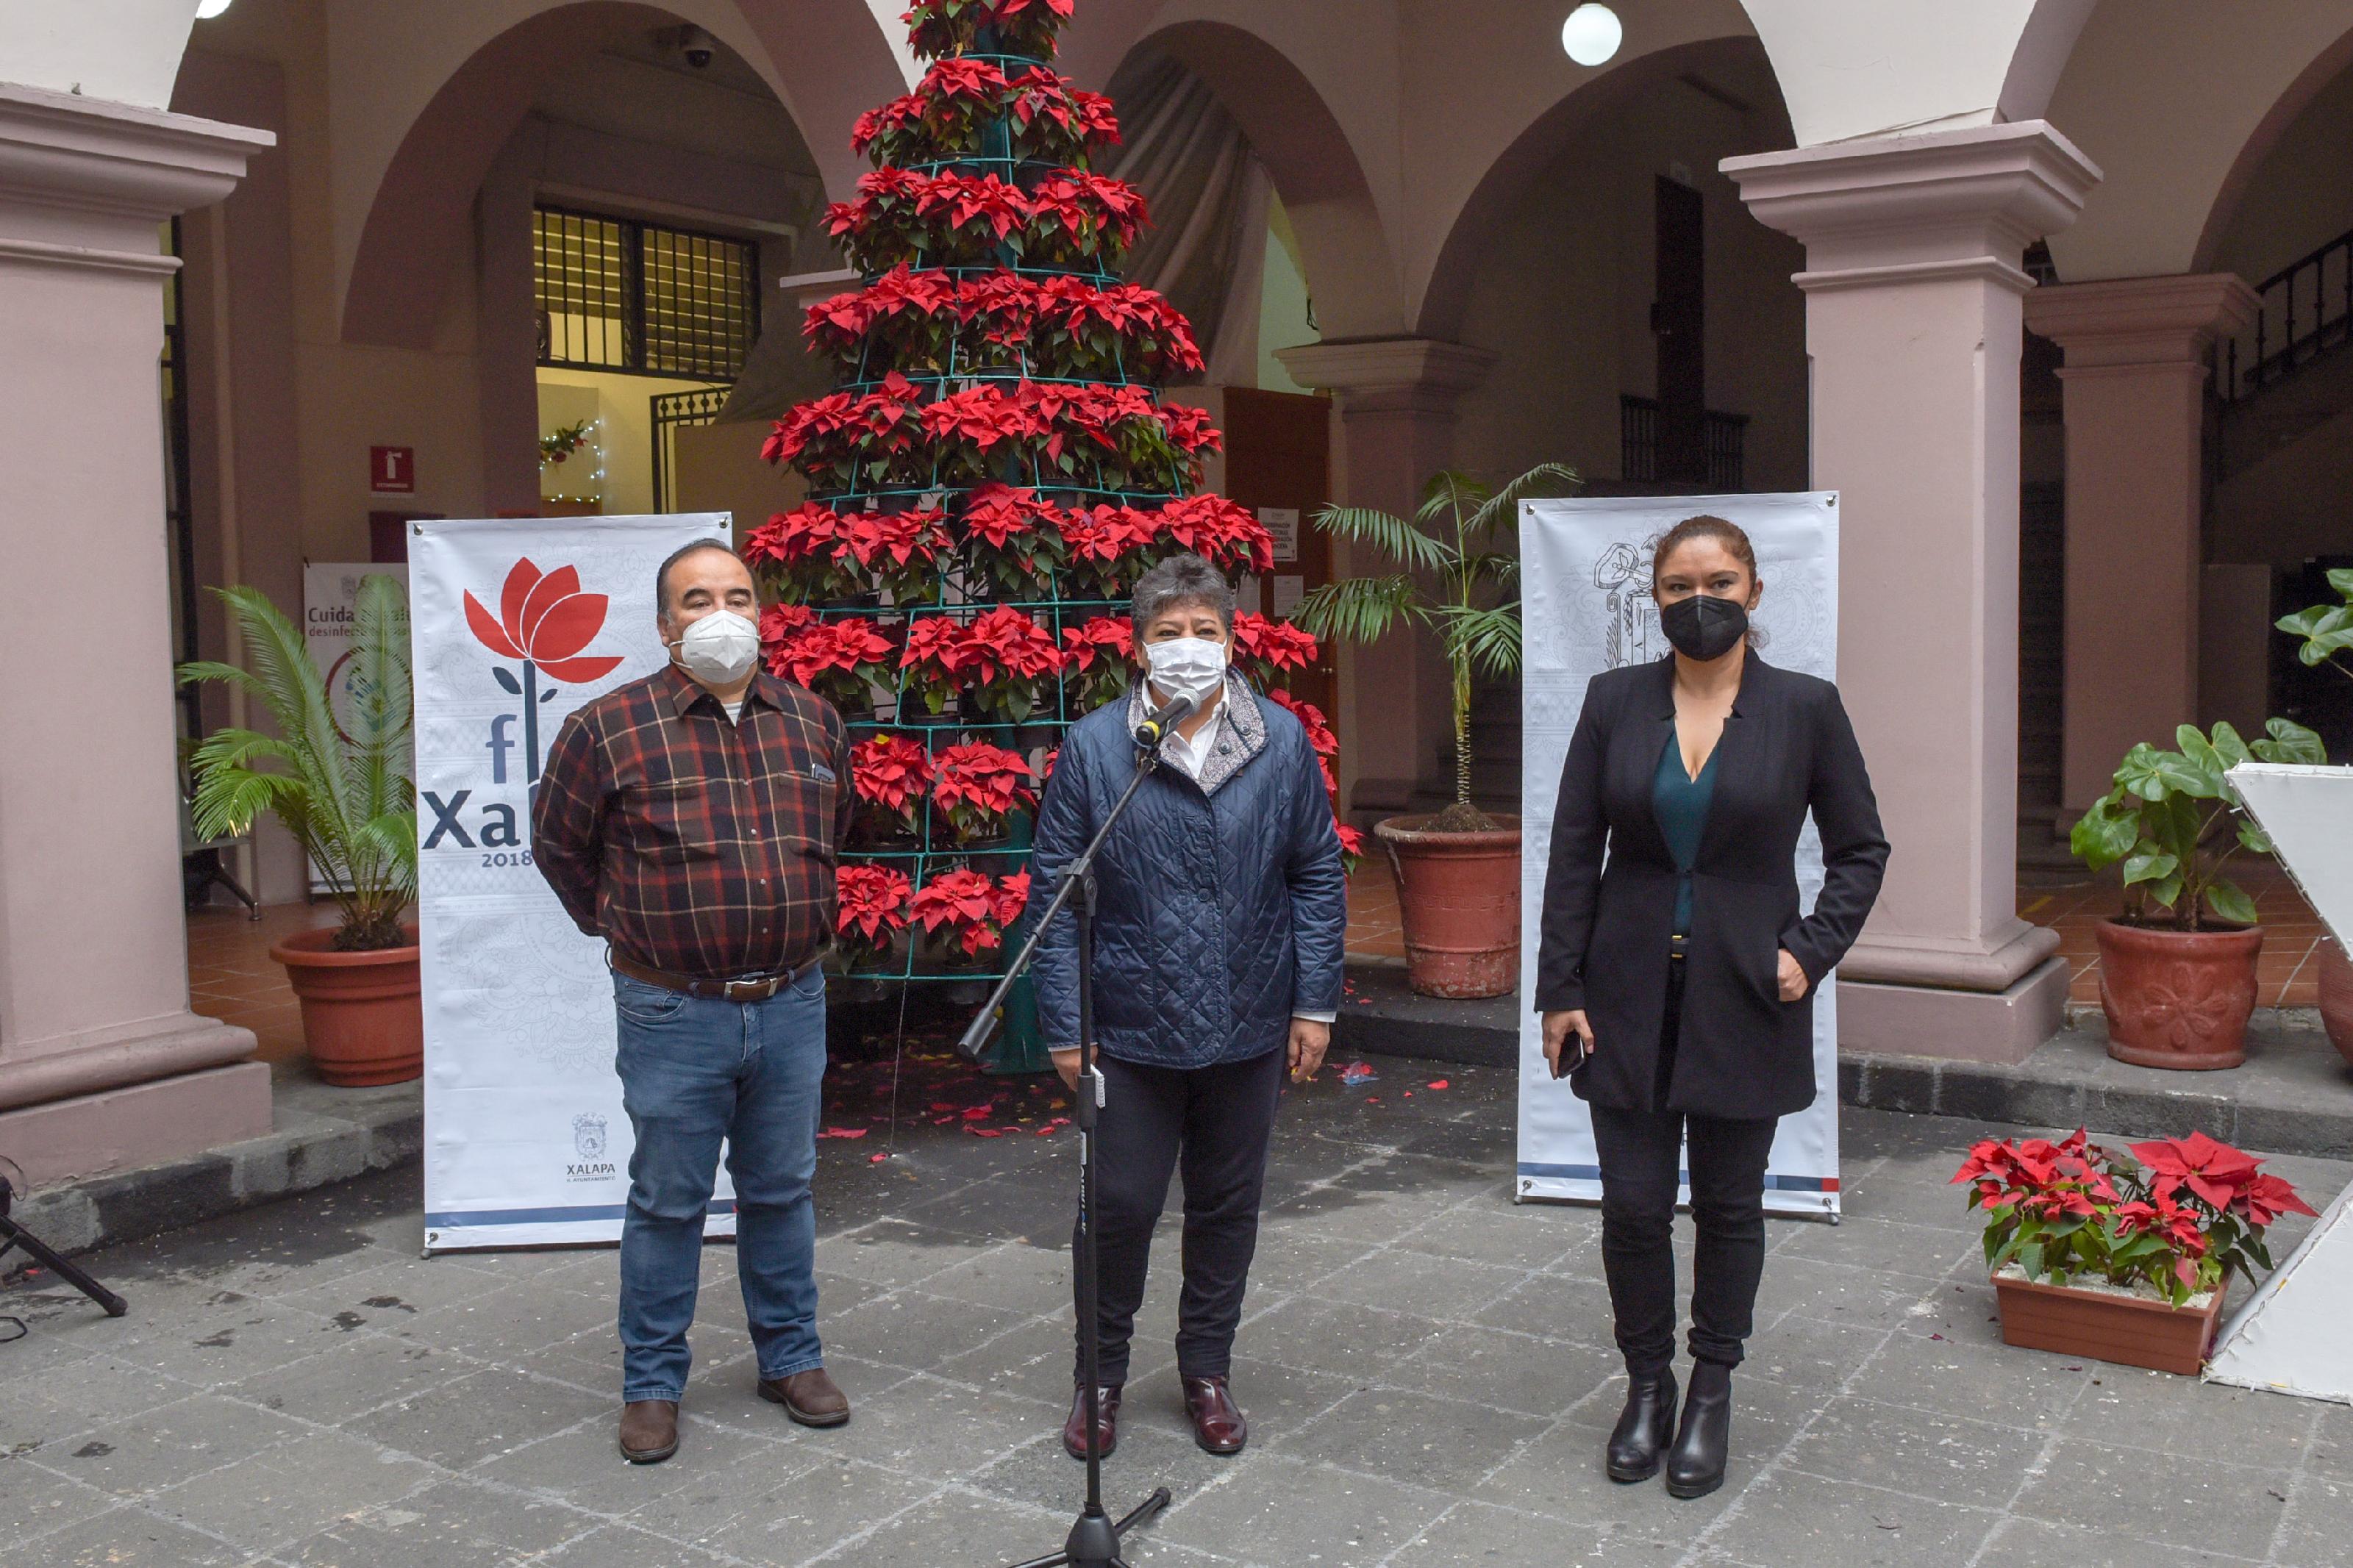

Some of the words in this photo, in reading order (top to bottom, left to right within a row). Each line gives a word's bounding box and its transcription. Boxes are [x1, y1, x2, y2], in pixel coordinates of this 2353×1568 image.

[308, 606, 354, 623] Cuida
[482, 850, 533, 867] 2018
[566, 1164, 615, 1175] XALAPA
